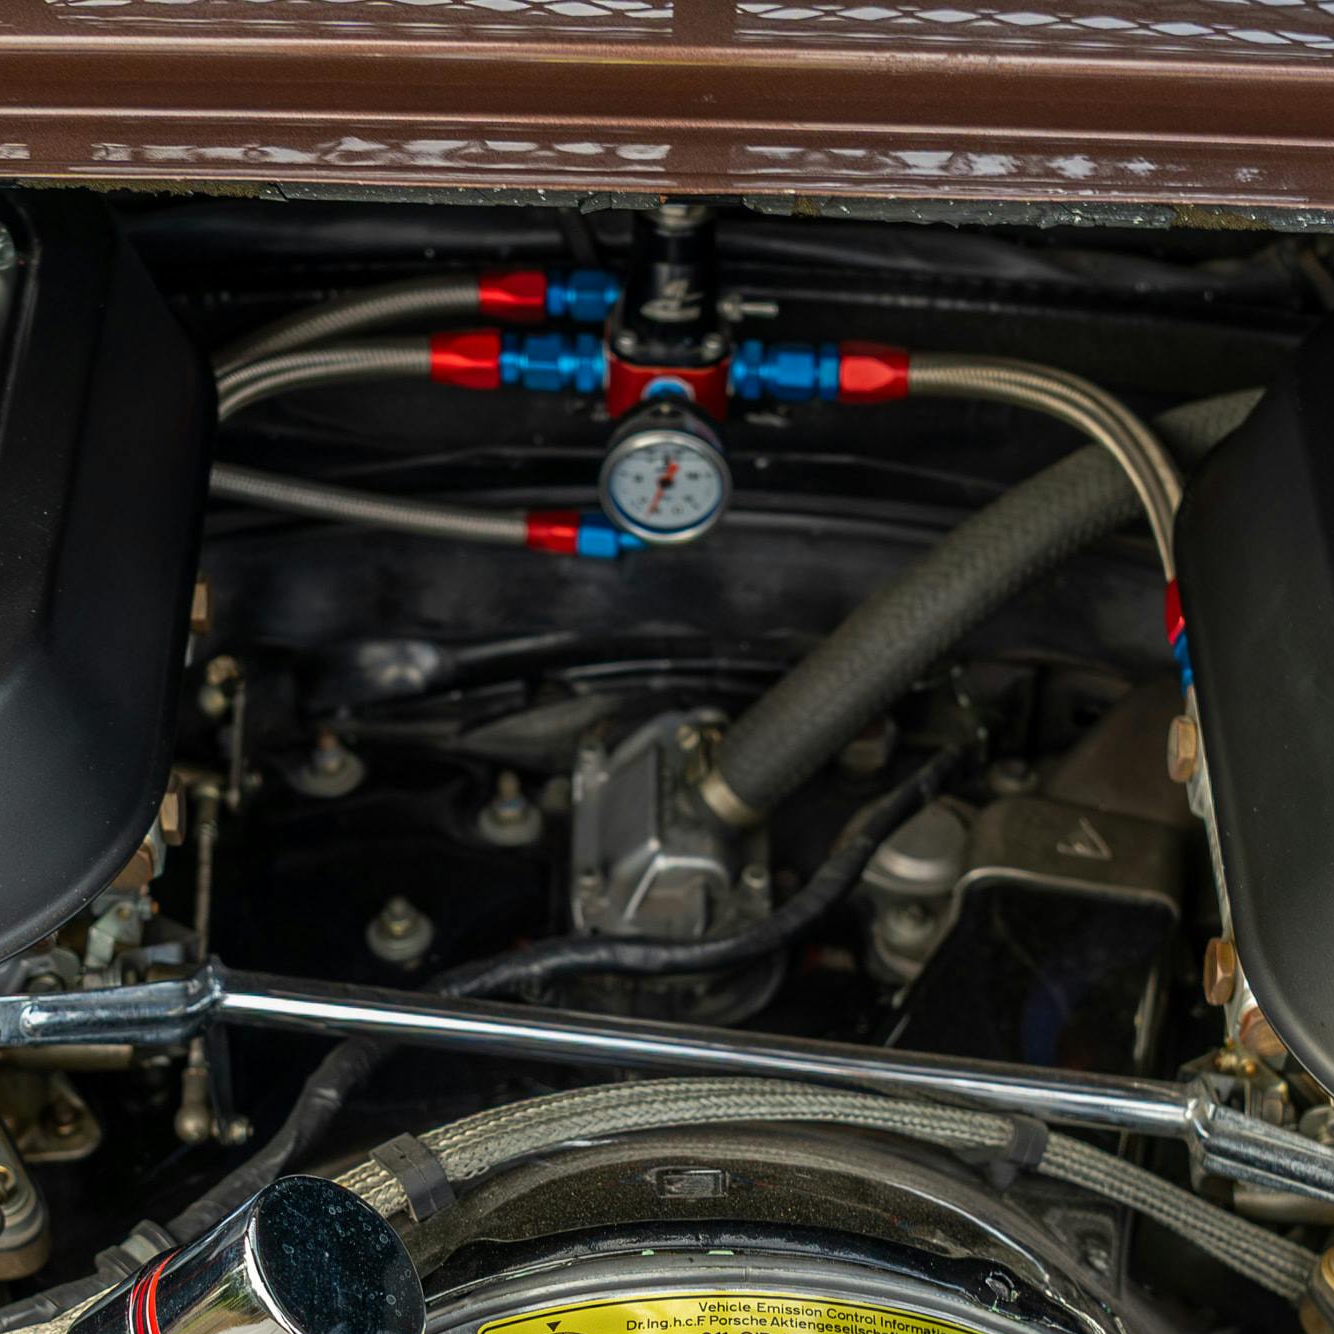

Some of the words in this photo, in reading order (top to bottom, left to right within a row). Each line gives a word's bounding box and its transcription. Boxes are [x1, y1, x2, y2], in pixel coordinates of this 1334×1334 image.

[699, 1302, 751, 1312] Vehicle
[757, 1302, 822, 1318] Emission
[827, 1309, 876, 1324] Control
[710, 1316, 767, 1326] Porsche
